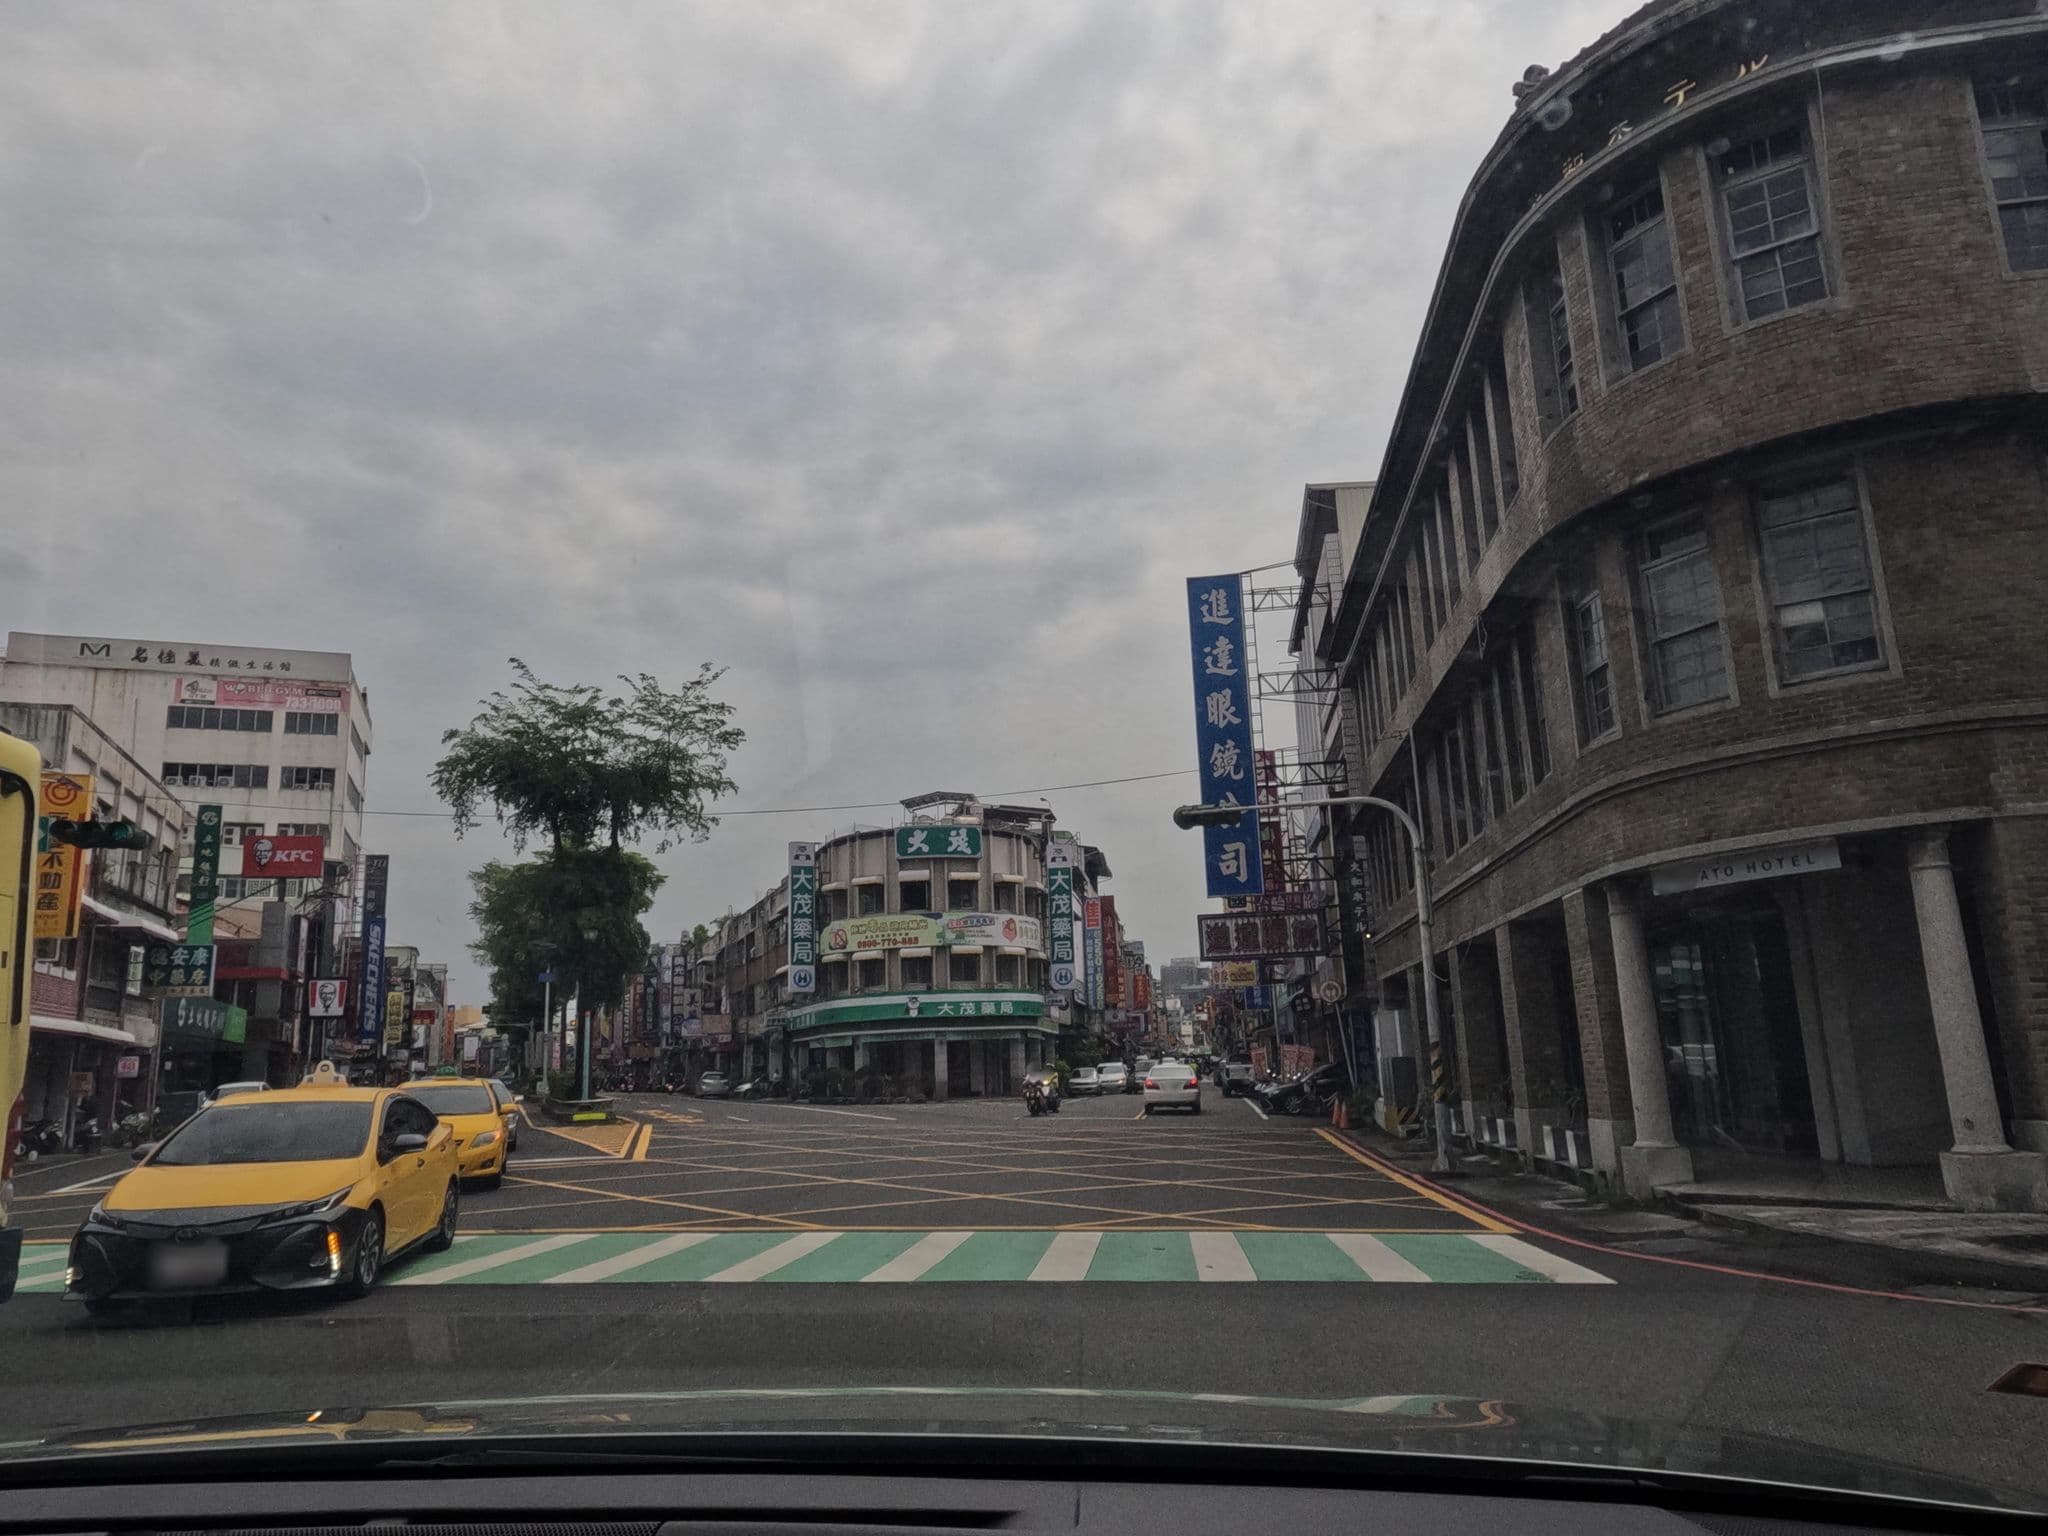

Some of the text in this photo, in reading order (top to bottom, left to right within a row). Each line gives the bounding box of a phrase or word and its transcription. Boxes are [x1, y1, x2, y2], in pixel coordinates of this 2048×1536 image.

[907, 828, 973, 855] 大茂
[274, 849, 315, 862] KFC
[1746, 855, 1816, 874] HOTEL
[792, 868, 813, 964] 大茂藥局
[1050, 866, 1073, 961] 大茂藥局
[363, 924, 383, 1033] SKECHERS
[937, 1002, 1014, 1015] 大茂藥局
